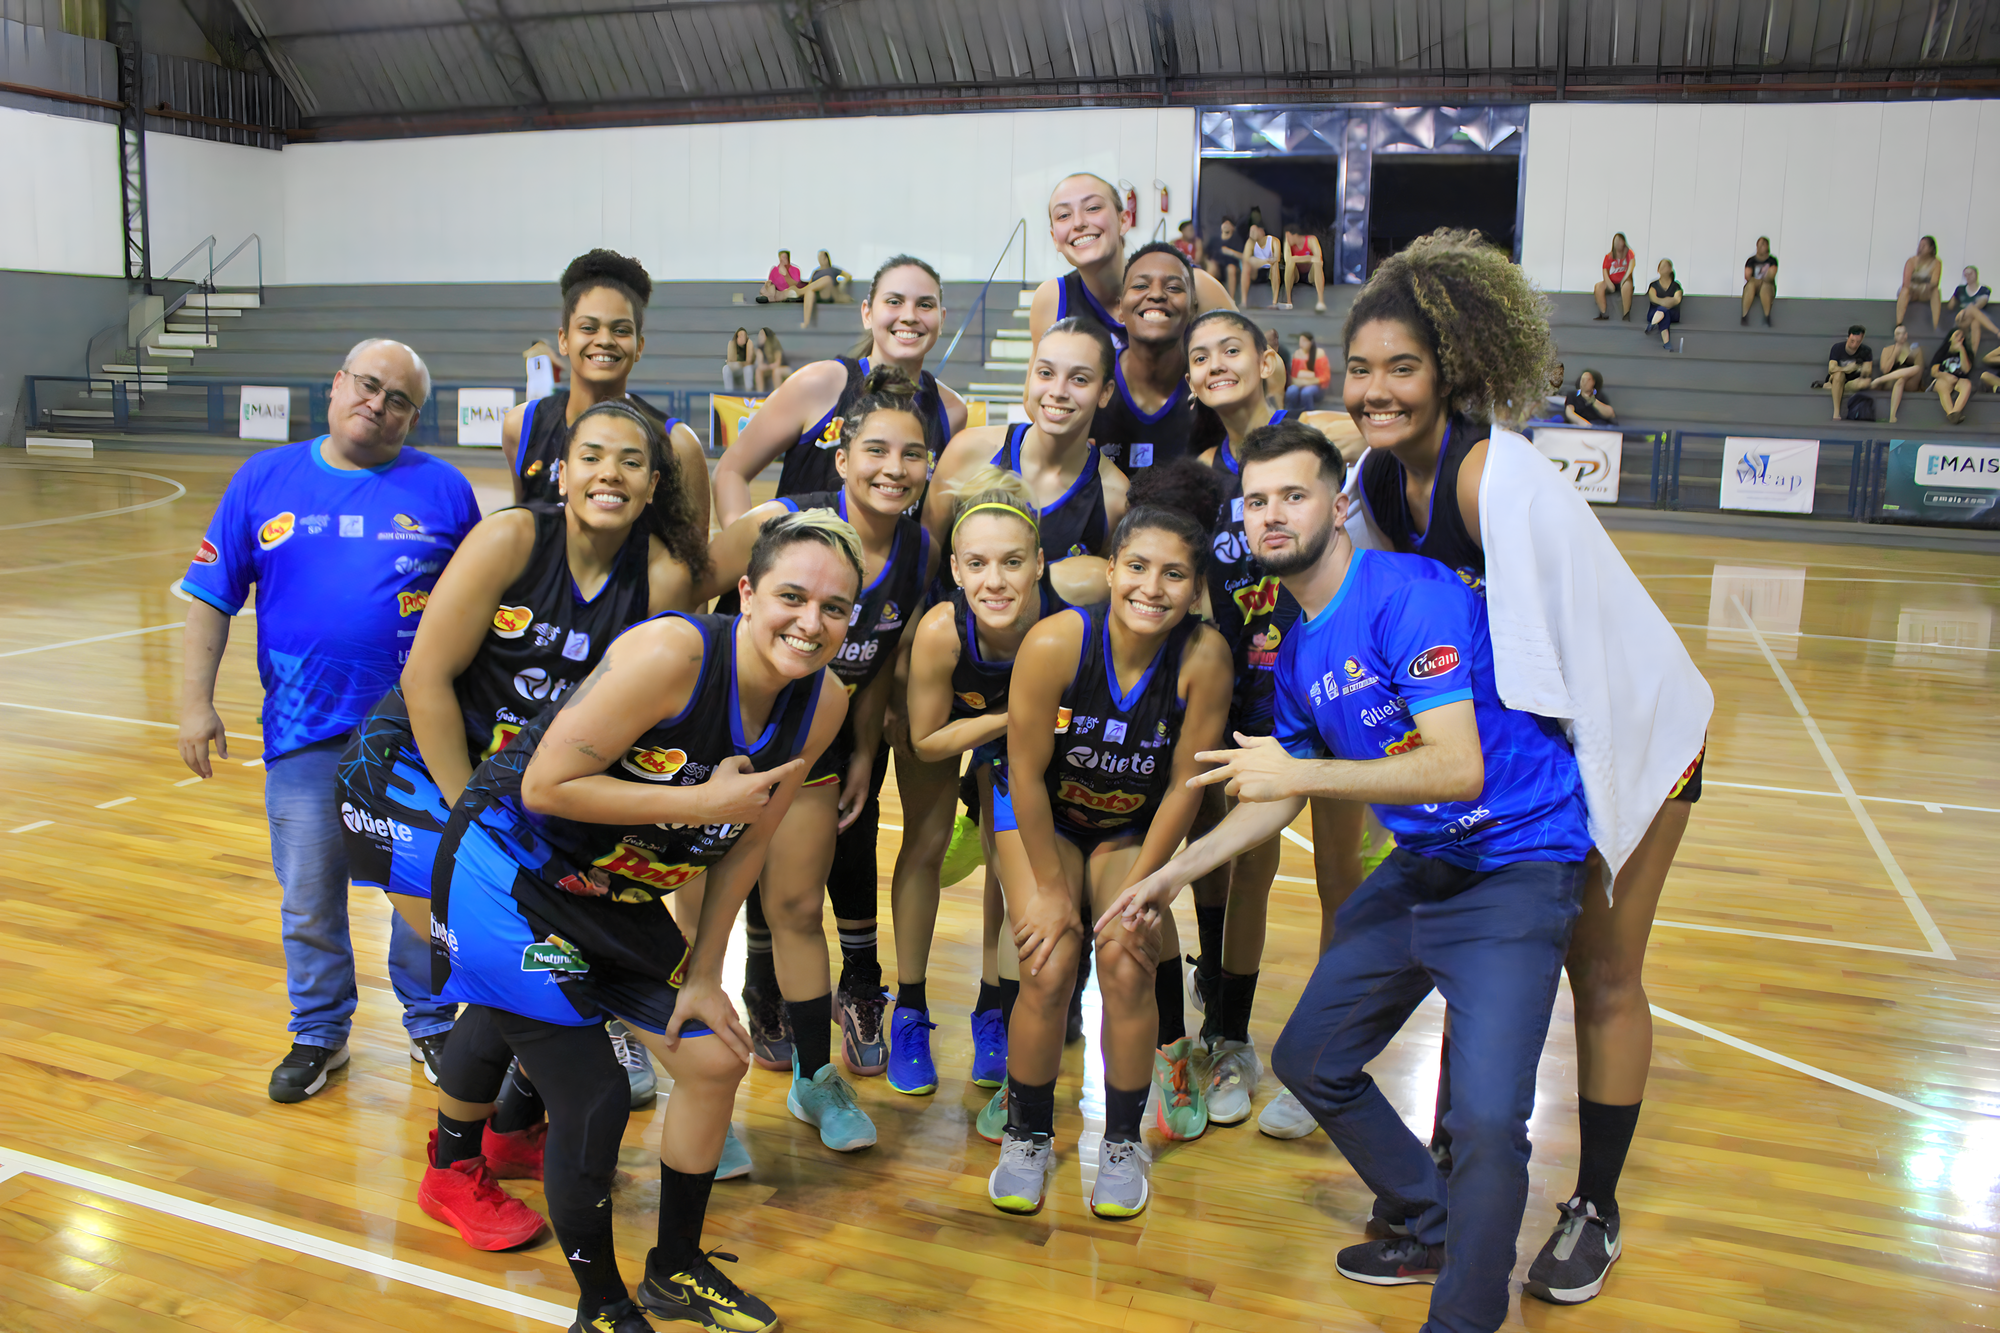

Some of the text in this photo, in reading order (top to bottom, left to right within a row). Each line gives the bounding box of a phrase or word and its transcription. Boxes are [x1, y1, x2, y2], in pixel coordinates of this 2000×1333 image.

[1926, 454, 2000, 475] EMAIS
[836, 637, 880, 662] ietê
[1099, 750, 1156, 775] tietê
